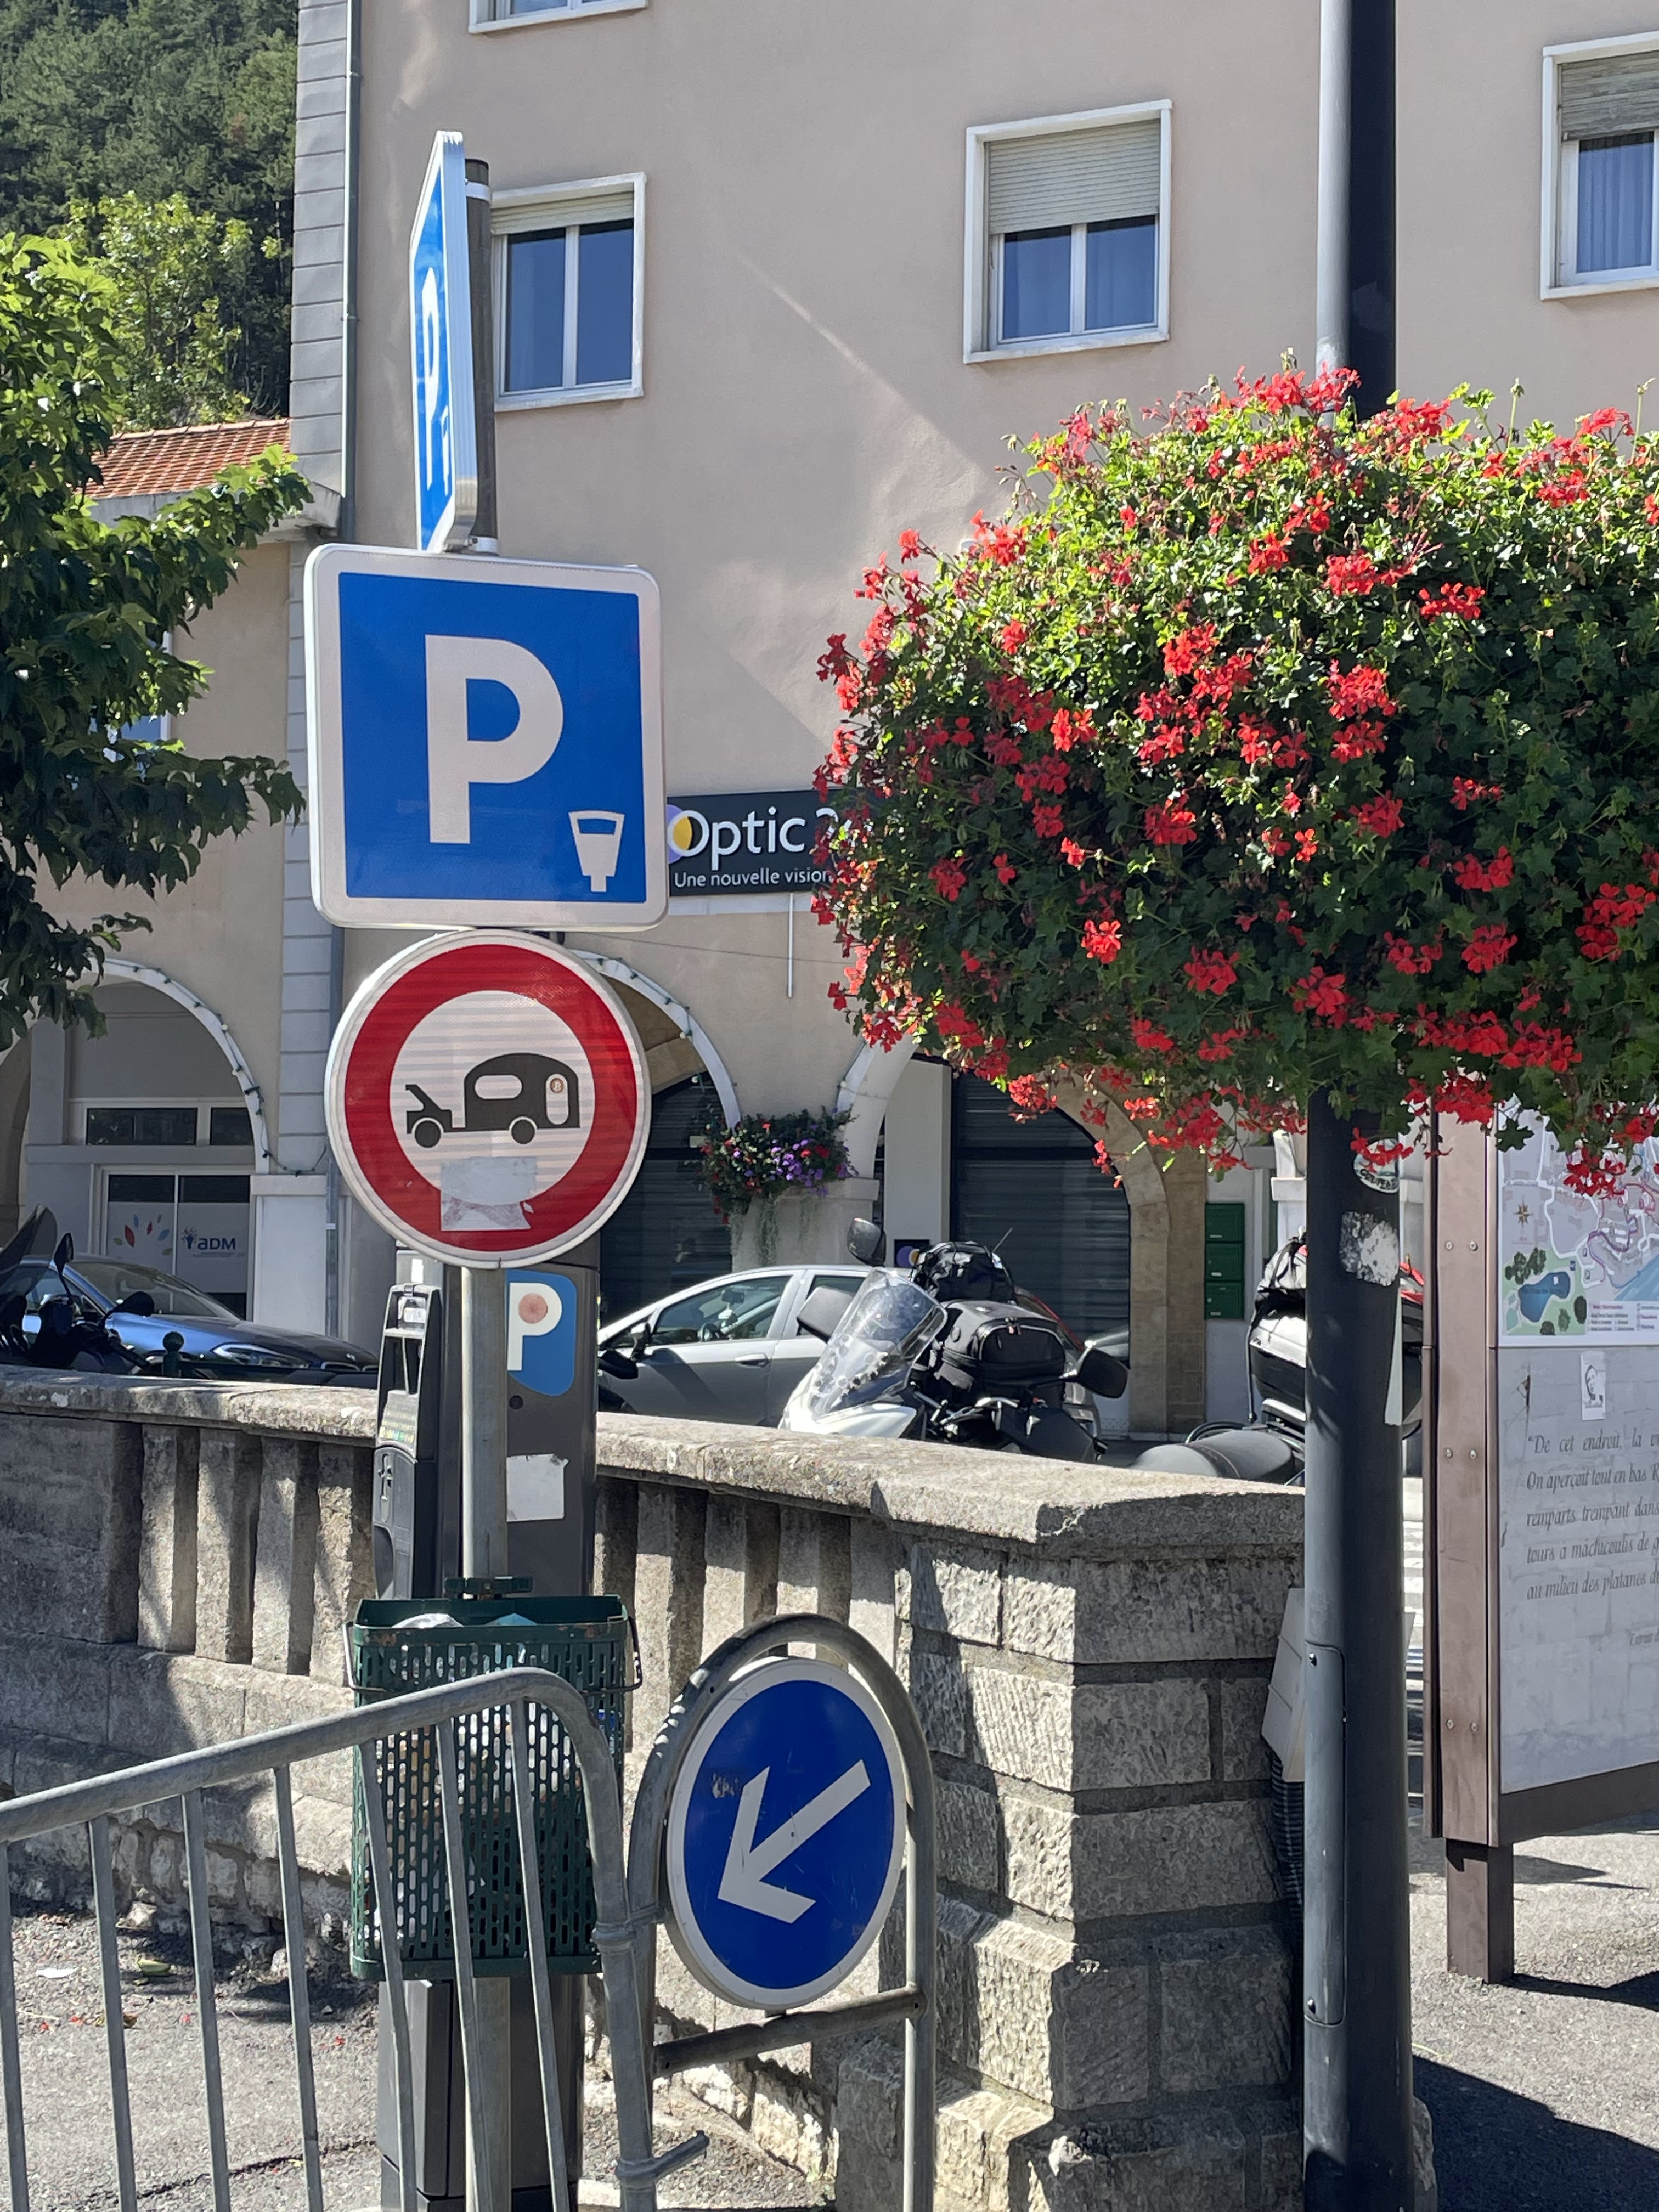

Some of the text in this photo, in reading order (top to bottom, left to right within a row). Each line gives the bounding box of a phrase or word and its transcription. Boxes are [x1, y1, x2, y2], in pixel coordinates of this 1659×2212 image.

[425, 634, 564, 844] P
[668, 806, 806, 871] Optic
[674, 871, 707, 888] Une
[710, 867, 780, 887] nouvelle
[507, 1283, 562, 1371] P
[1559, 1435, 1574, 1453] cet
[1583, 1429, 1623, 1451] endroit,
[1632, 1427, 1642, 1448] la
[1527, 1471, 1543, 1491] On
[1592, 1468, 1612, 1486] tout
[1613, 1470, 1626, 1484] en
[1629, 1462, 1646, 1482] bas
[1526, 1506, 1576, 1531] remparts
[1582, 1501, 1630, 1525] trempant
[1527, 1546, 1555, 1564] tours
[1637, 1531, 1649, 1551] de
[1527, 1584, 1542, 1600] au
[1545, 1575, 1579, 1598] milieu
[1582, 1571, 1599, 1594] des
[1602, 1569, 1646, 1596] platanes
